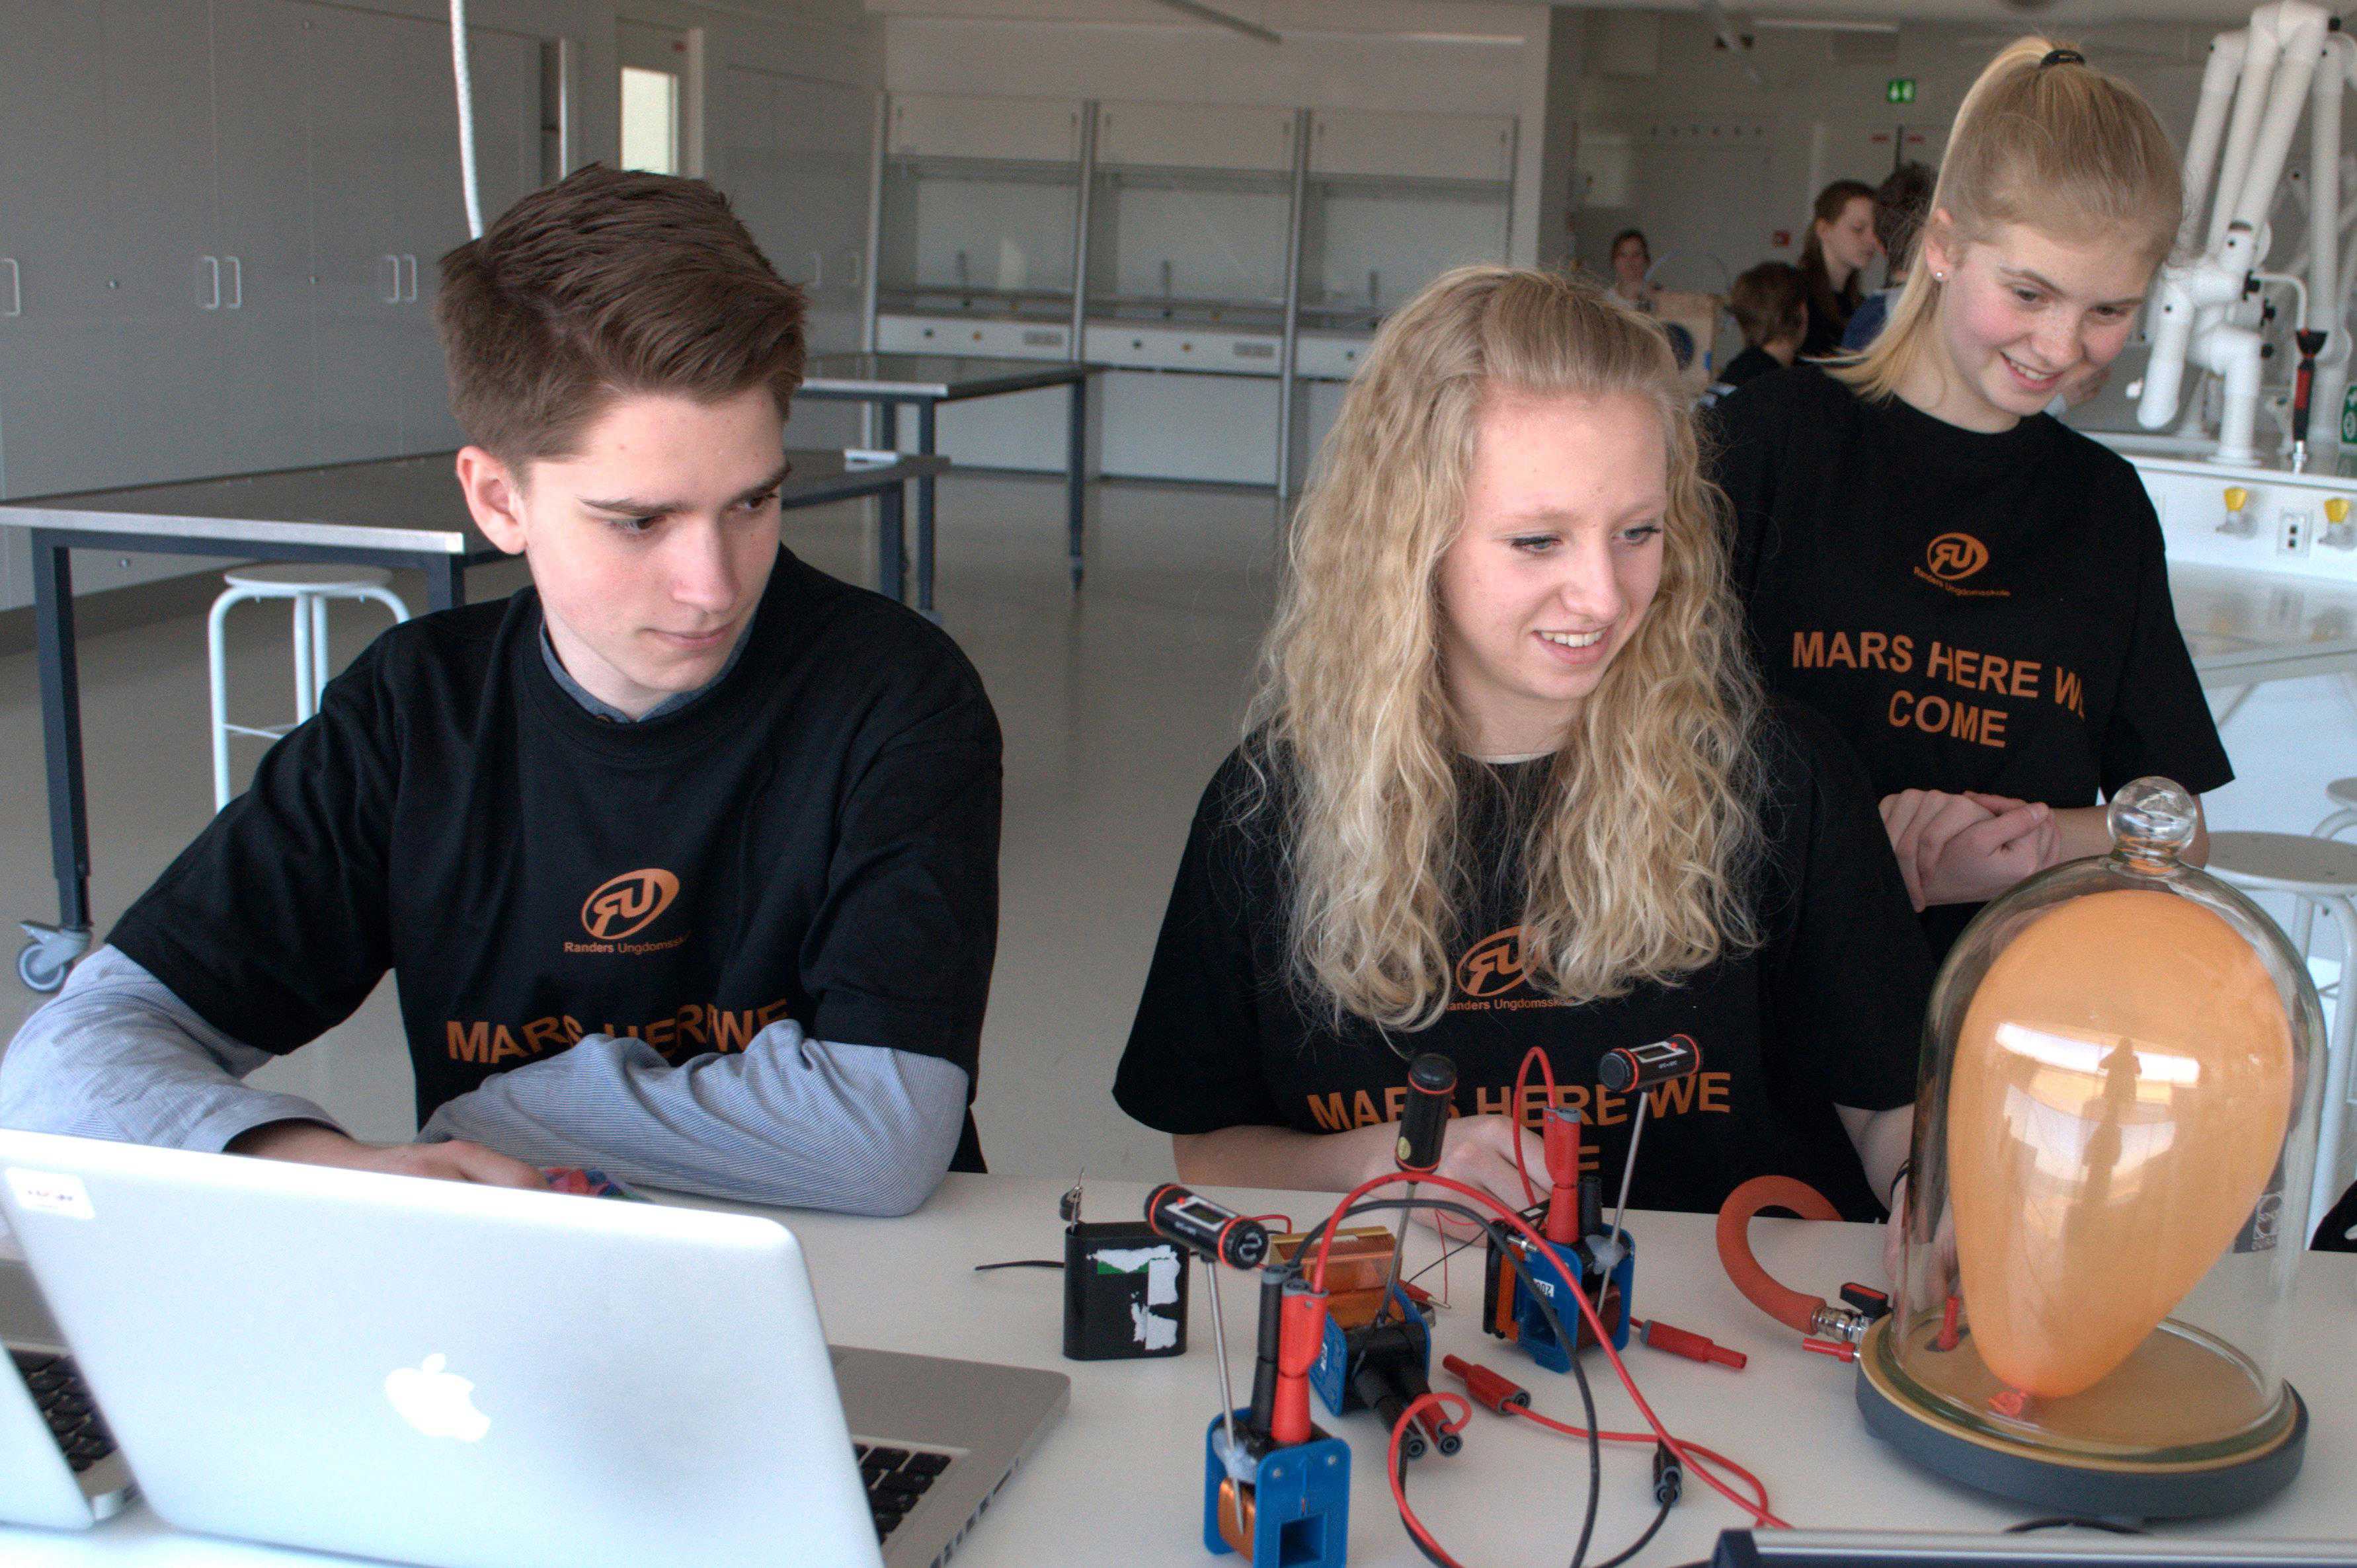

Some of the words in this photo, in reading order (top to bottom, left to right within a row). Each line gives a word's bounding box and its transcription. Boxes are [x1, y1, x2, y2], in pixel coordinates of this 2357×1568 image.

[1792, 631, 1914, 673] MARS
[1927, 641, 2041, 697] HERE
[2054, 666, 2084, 719] W
[1889, 690, 2008, 748] COME
[564, 941, 614, 953] Randers
[1307, 1086, 1460, 1130] MAR
[1649, 1072, 1737, 1118] WE
